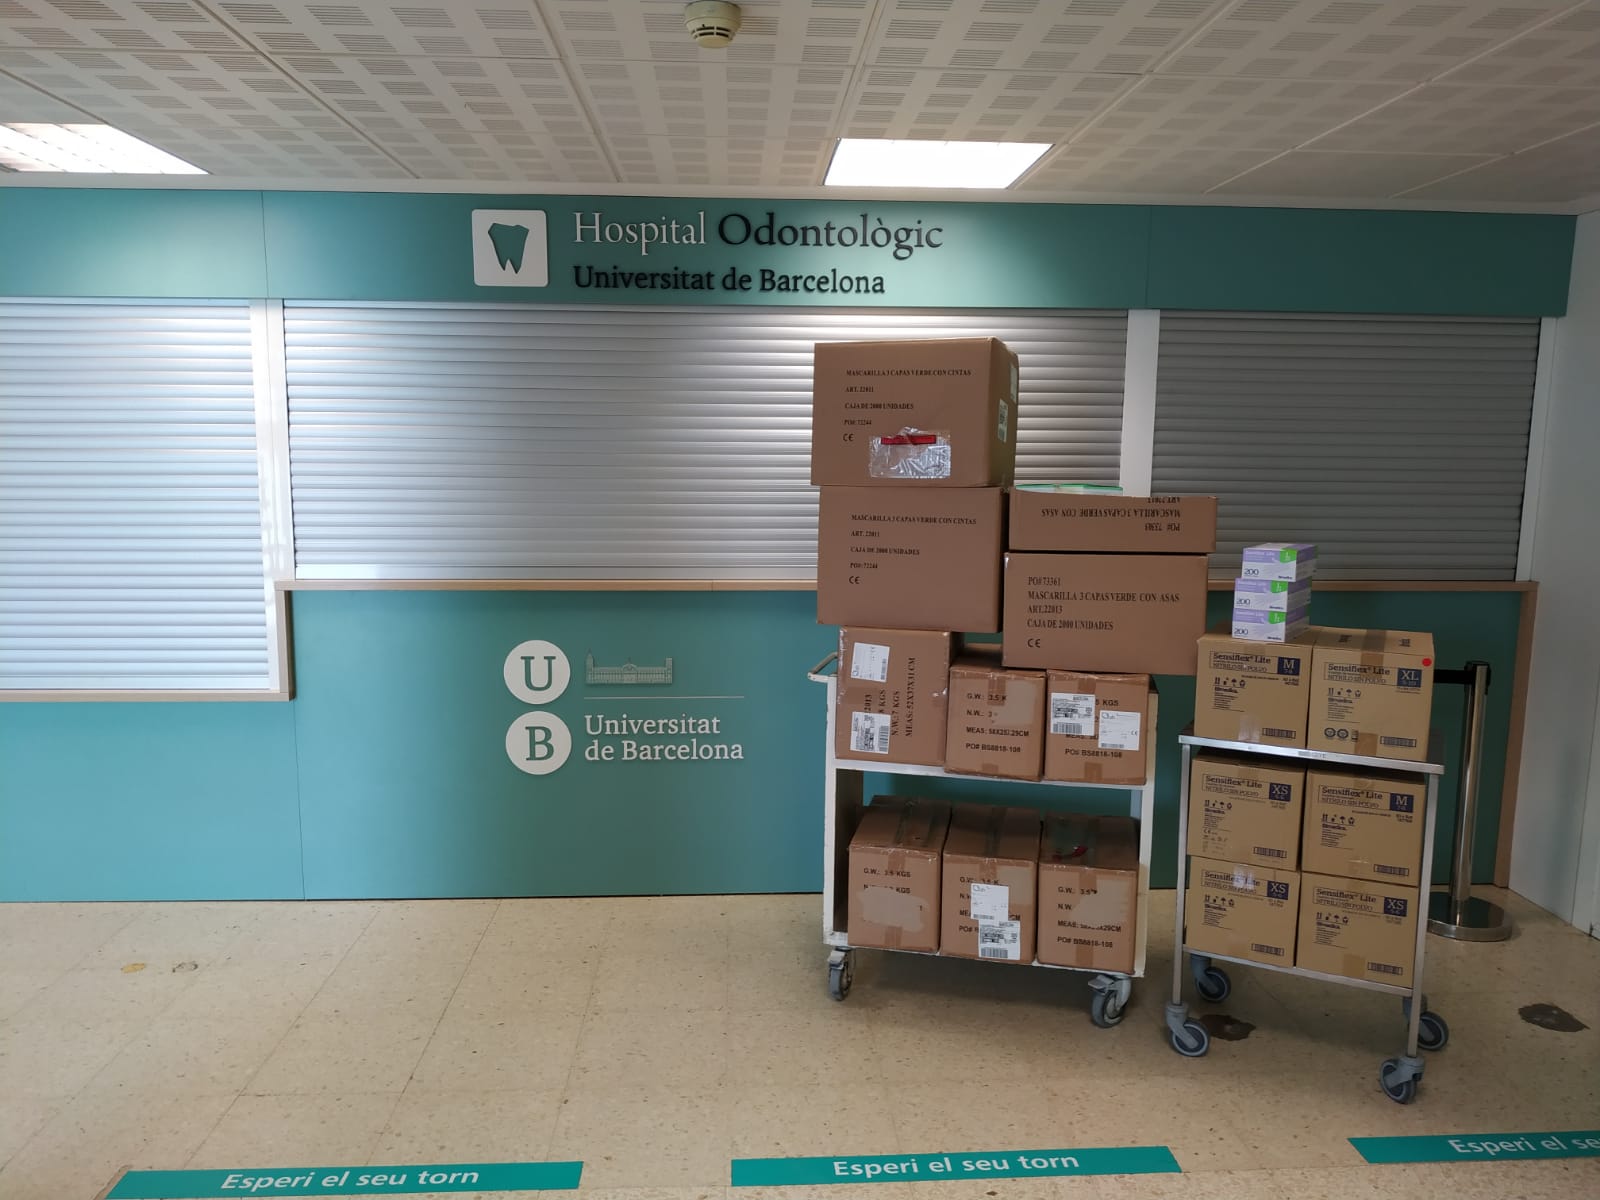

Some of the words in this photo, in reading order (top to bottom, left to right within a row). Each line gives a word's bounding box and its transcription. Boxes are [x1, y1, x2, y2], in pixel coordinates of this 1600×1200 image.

[573, 211, 707, 255] Hospital
[717, 213, 944, 261] Odontològic
[573, 265, 717, 290] Universitat
[721, 267, 753, 291] de
[759, 268, 886, 294] Barcelona
[1028, 590, 1077, 600] MASCARILLA
[1079, 592, 1084, 601] 3
[1084, 592, 1110, 601] CAPAS
[1110, 592, 1137, 602] VERDE
[1139, 593, 1157, 602] CON
[1159, 593, 1180, 602] ASAS
[1027, 619, 1047, 628] CAJA
[1047, 620, 1057, 629] DE
[1058, 620, 1074, 629] 2000
[1074, 621, 1114, 630] UNIDADES
[520, 655, 556, 691] U
[1283, 659, 1295, 669] M
[1401, 670, 1419, 681] XL
[584, 714, 721, 736] Universitat
[524, 726, 555, 761] B
[584, 740, 614, 761] de
[622, 739, 744, 761] Barcelona
[1272, 784, 1289, 795] XS
[1395, 795, 1408, 806] M
[1271, 883, 1287, 893] XS
[1387, 899, 1405, 910] XS
[1448, 1137, 1537, 1155] Esperi
[1540, 1136, 1568, 1150] el
[1571, 1137, 1600, 1150] se
[832, 1158, 918, 1179] Esperi
[928, 1156, 952, 1173] el
[962, 1158, 1010, 1172] seu
[1018, 1153, 1080, 1170] torn
[221, 1171, 314, 1193] Esperi
[322, 1170, 347, 1187] el
[356, 1172, 407, 1187] seu
[418, 1170, 480, 1186] torn
